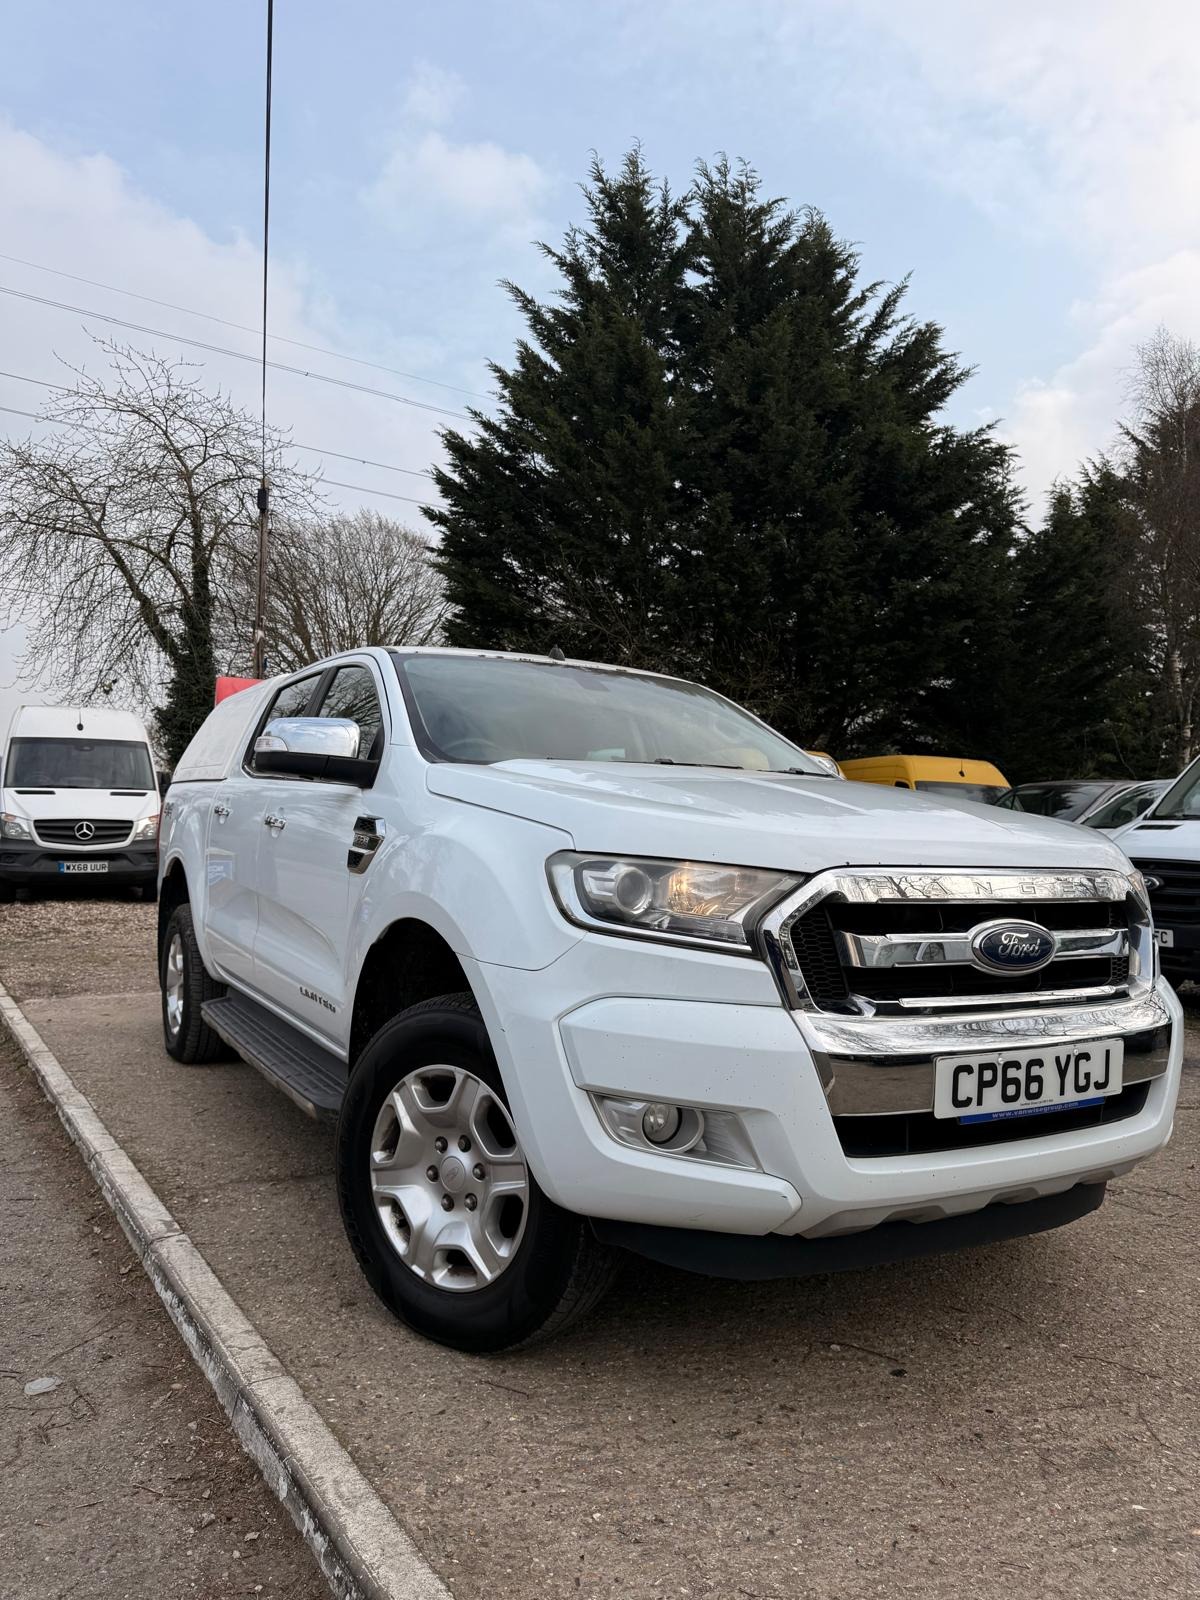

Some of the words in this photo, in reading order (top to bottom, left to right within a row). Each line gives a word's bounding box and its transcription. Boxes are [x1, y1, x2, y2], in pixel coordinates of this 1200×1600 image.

[65, 863, 88, 872] WX68
[90, 863, 107, 872] UUR
[999, 932, 1041, 957] Ford
[952, 1058, 1045, 1109] CP66
[1055, 1049, 1111, 1096] YGJ
[992, 1101, 1079, 1119] www.vanwisegroup.com
